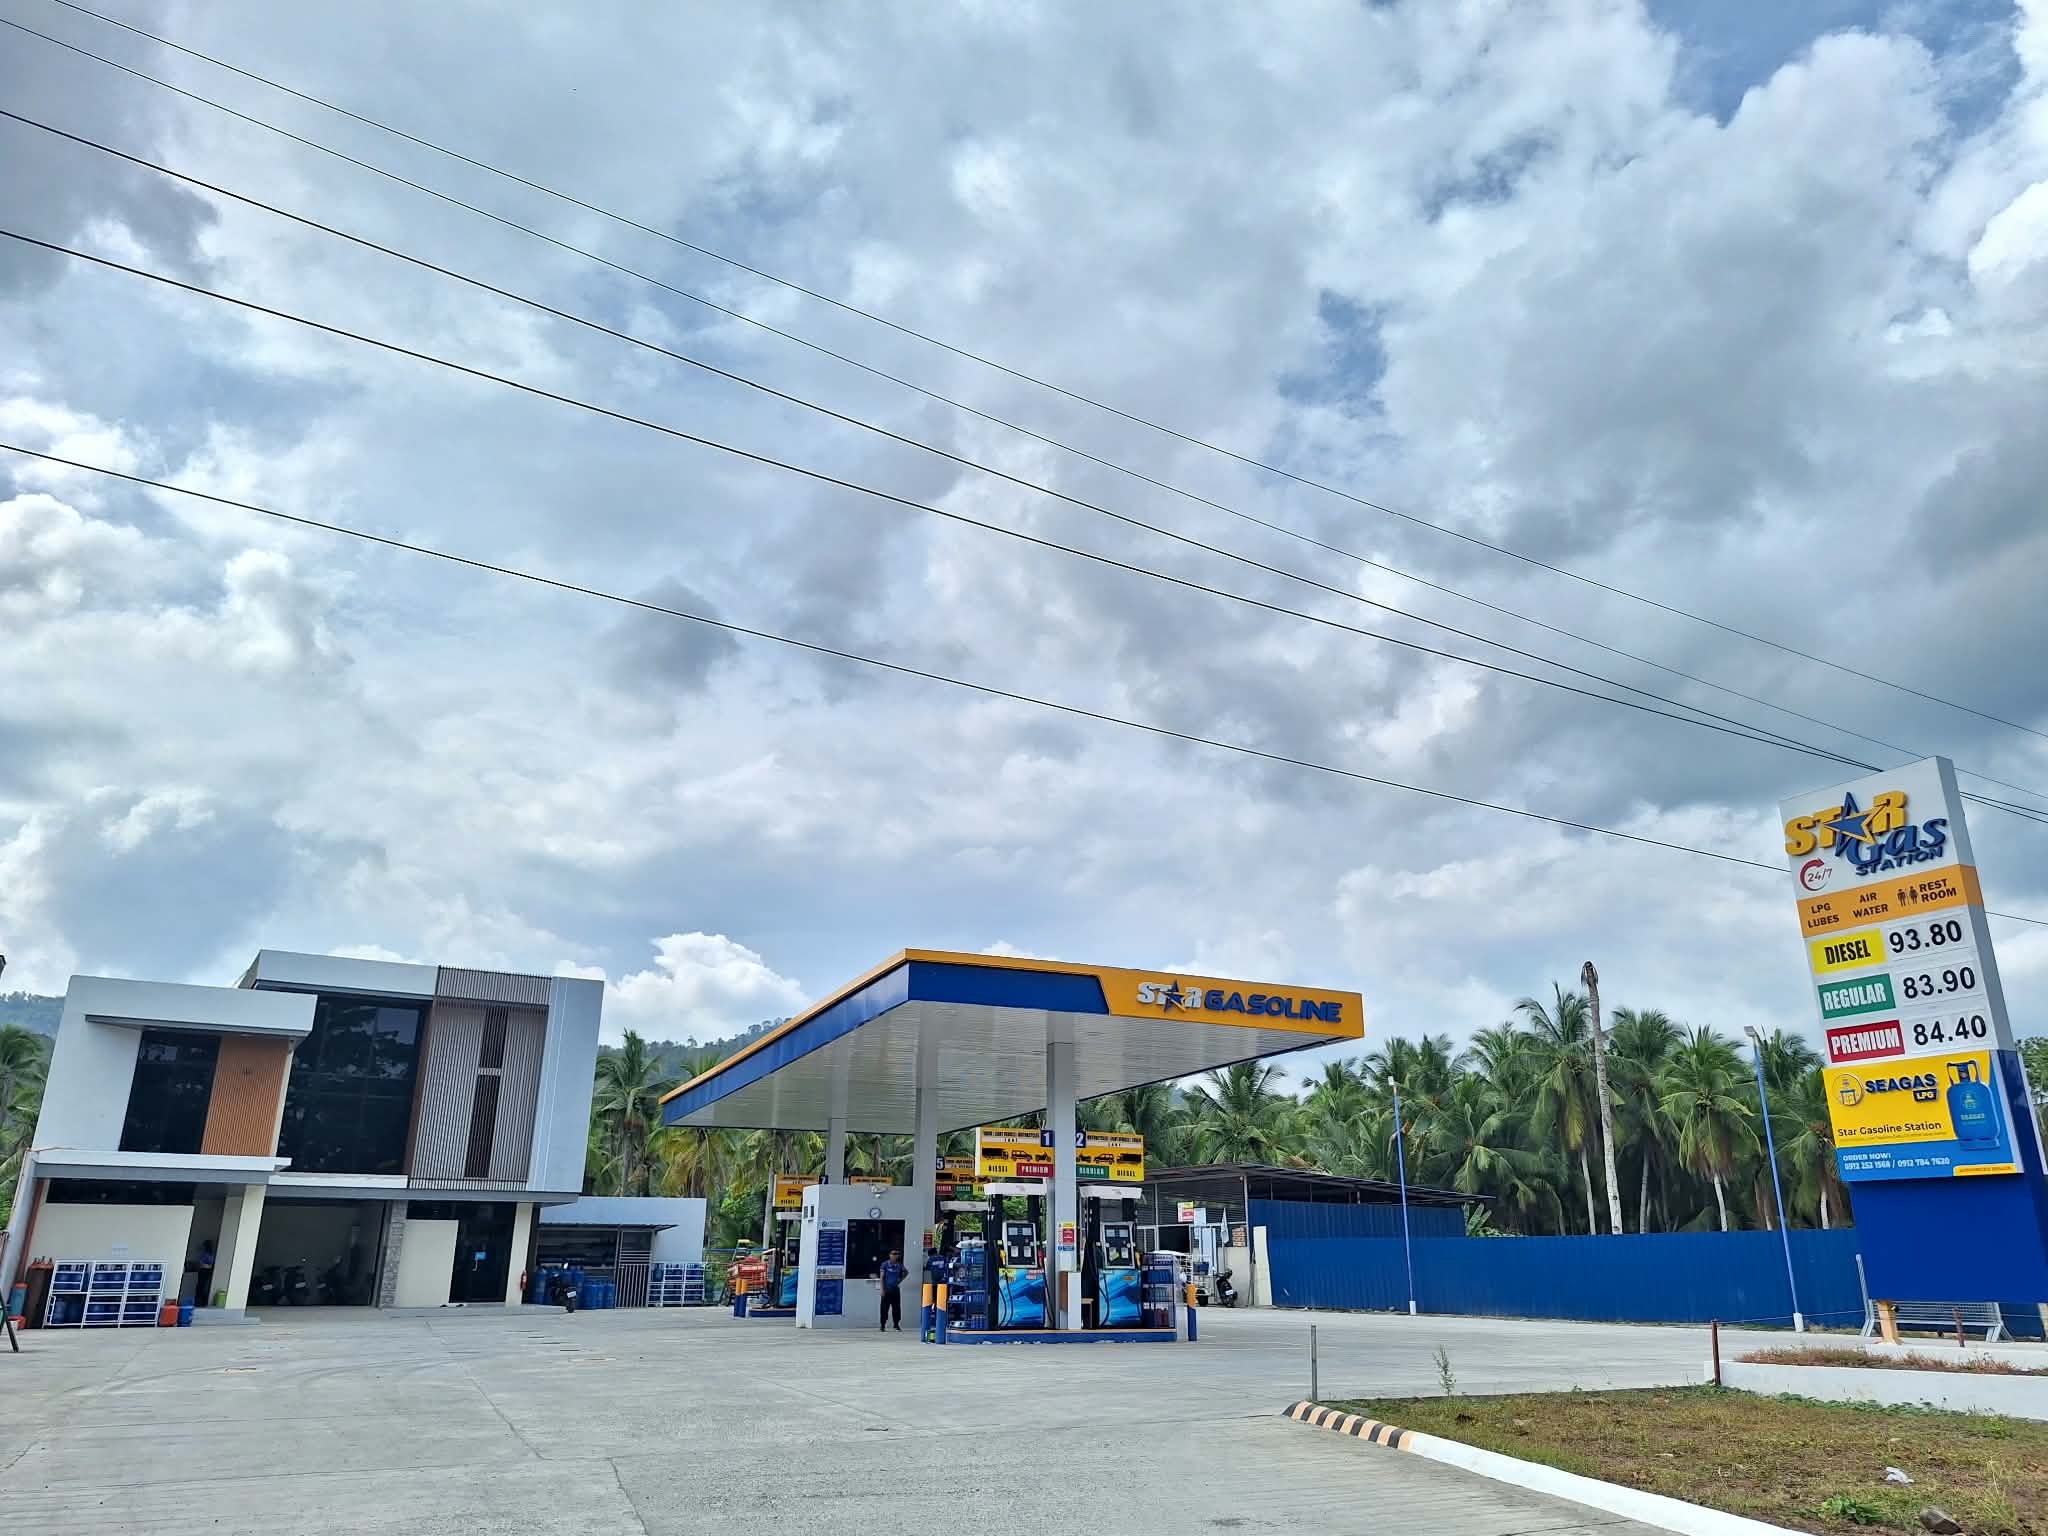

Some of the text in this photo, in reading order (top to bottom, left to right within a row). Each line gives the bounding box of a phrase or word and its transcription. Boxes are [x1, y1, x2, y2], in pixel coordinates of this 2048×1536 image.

[1785, 790, 1908, 857] STAR
[1846, 818, 1948, 866] Gas
[1856, 846, 1944, 877] STATION
[1807, 867, 1833, 883] 24/7
[1919, 878, 1948, 893] REST
[1859, 892, 1877, 903] AIR
[1921, 887, 1957, 903] ROOM
[1811, 903, 1831, 914] LPG
[1853, 903, 1889, 918] WATER
[1807, 915, 1840, 928] LUBES
[1824, 920, 1962, 965] DIESEL 93.80
[1822, 966, 1976, 1011] REGULAR 83.90
[1136, 980, 1343, 1023] STAR GASOLINE
[1830, 1014, 1987, 1055] PREMIUM 84.40
[1865, 1073, 1938, 1094] SEAGAS
[1915, 1091, 1935, 1100] LPG
[1837, 1128, 1857, 1137] Star
[1859, 1124, 1902, 1135] Gasoline
[1904, 1121, 1942, 1132] Station
[1042, 1132, 1050, 1146] 1
[1076, 1132, 1084, 1147] 2
[936, 1157, 944, 1170] 5
